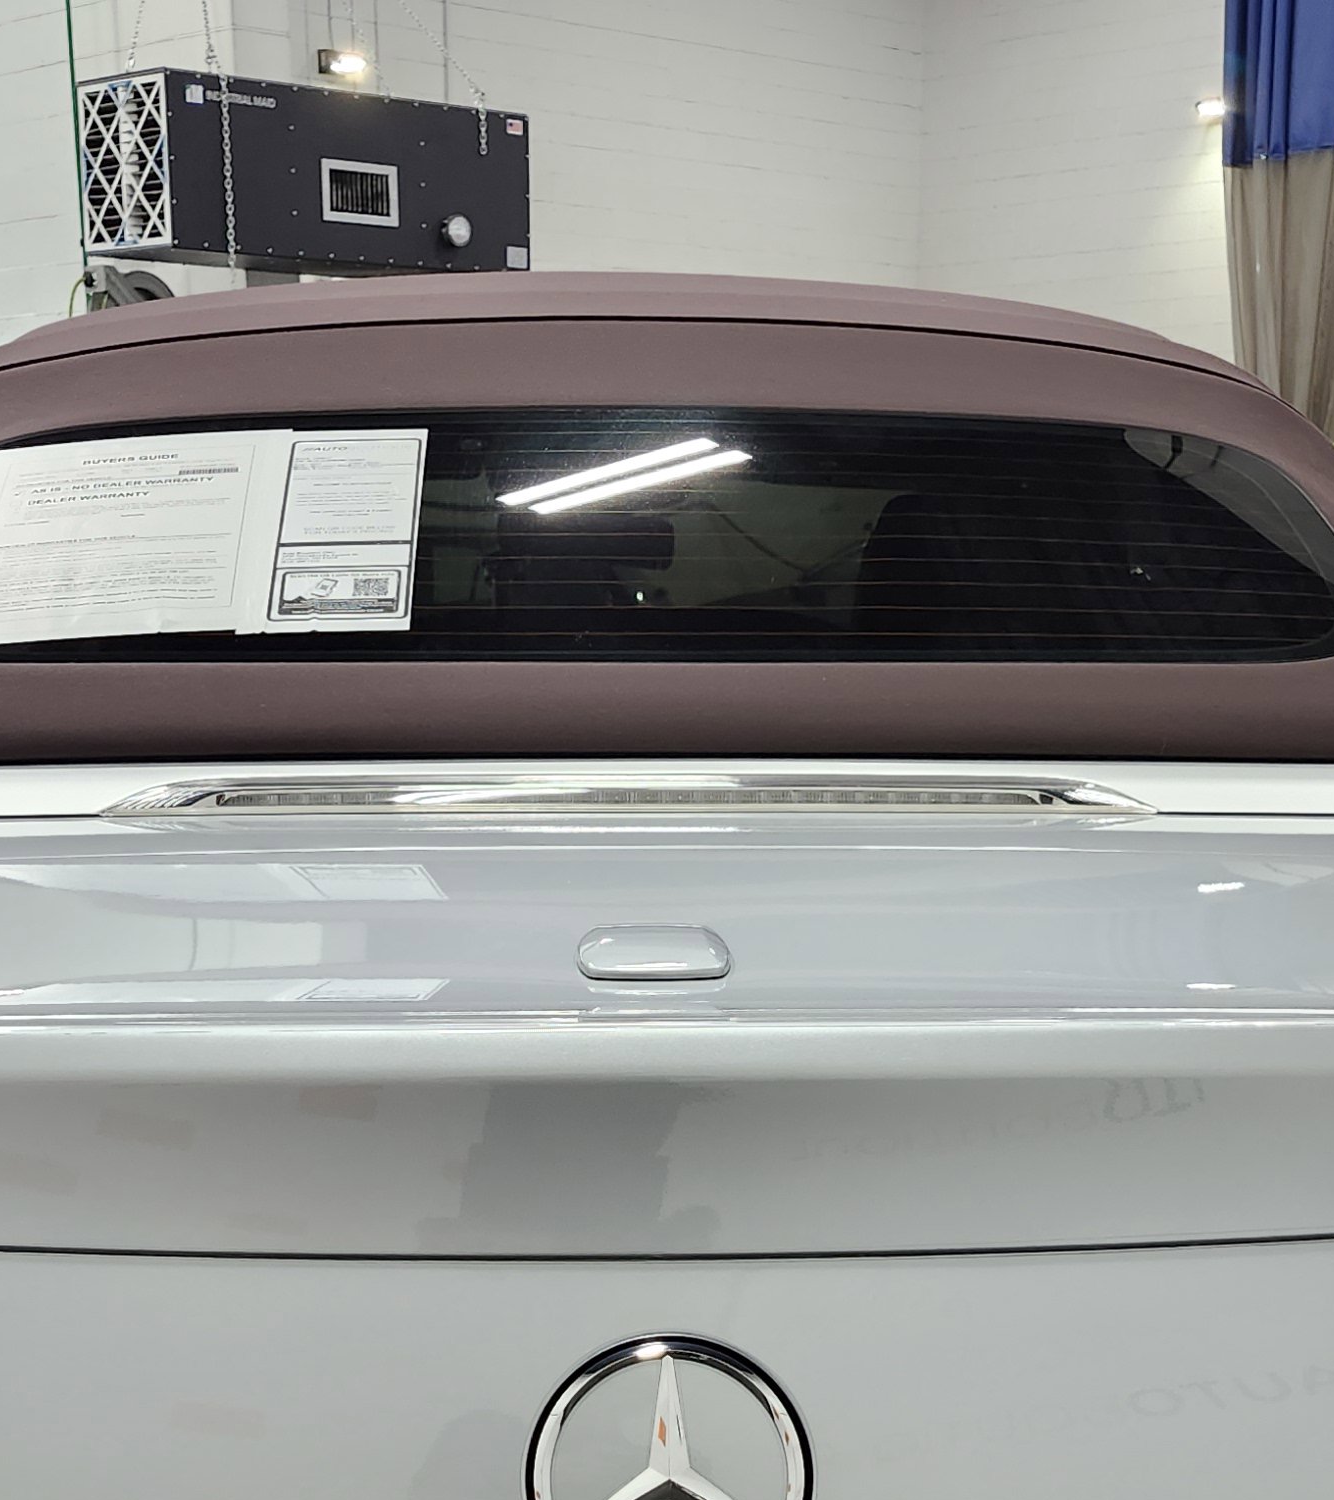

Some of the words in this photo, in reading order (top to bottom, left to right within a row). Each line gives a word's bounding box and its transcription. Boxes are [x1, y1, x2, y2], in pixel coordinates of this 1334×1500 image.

[82, 456, 136, 466] BUYERS
[139, 453, 179, 462] GUIDE
[72, 483, 91, 491] NO
[93, 479, 143, 489] DEALER
[145, 475, 215, 486] WARRANTY
[27, 495, 77, 506] DEALER
[80, 490, 150, 502] WARRANTY
